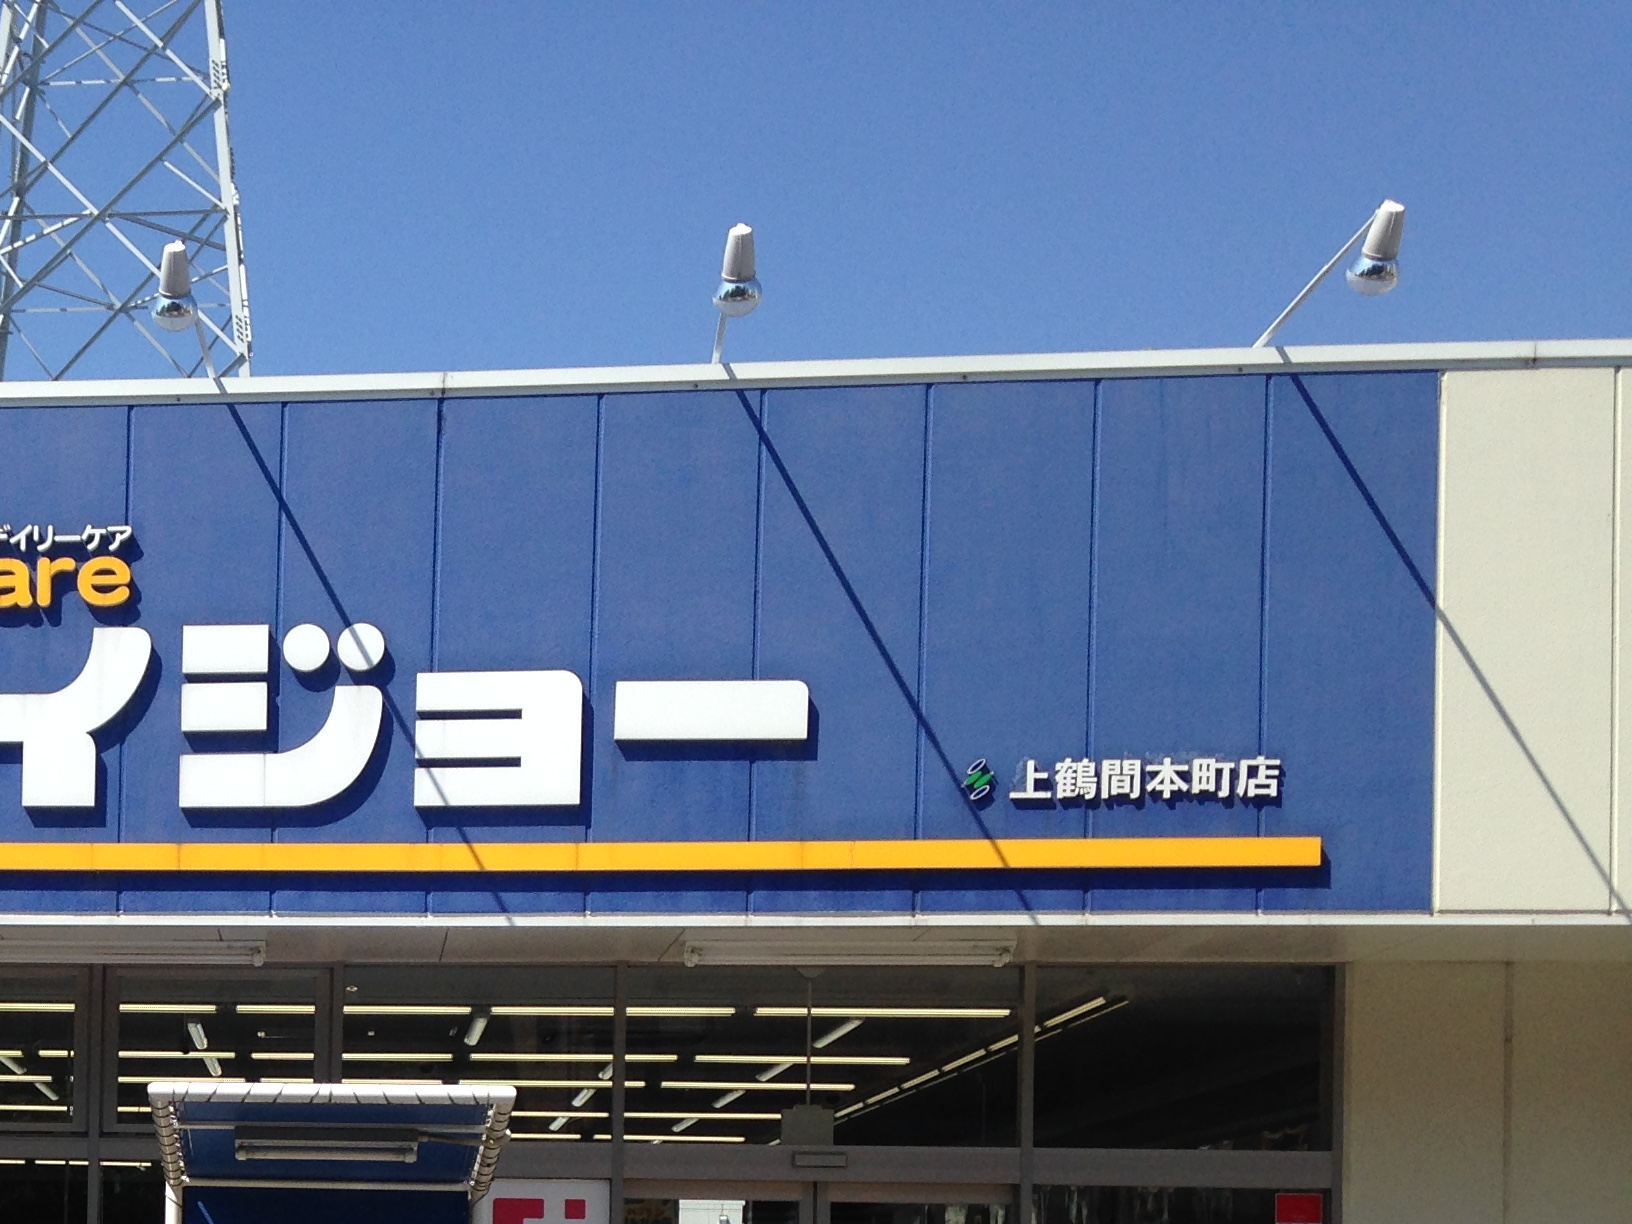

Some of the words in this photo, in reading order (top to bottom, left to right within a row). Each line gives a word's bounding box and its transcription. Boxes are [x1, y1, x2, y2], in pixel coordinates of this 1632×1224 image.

[1008, 757, 1282, 803] 上鶴間本町店
